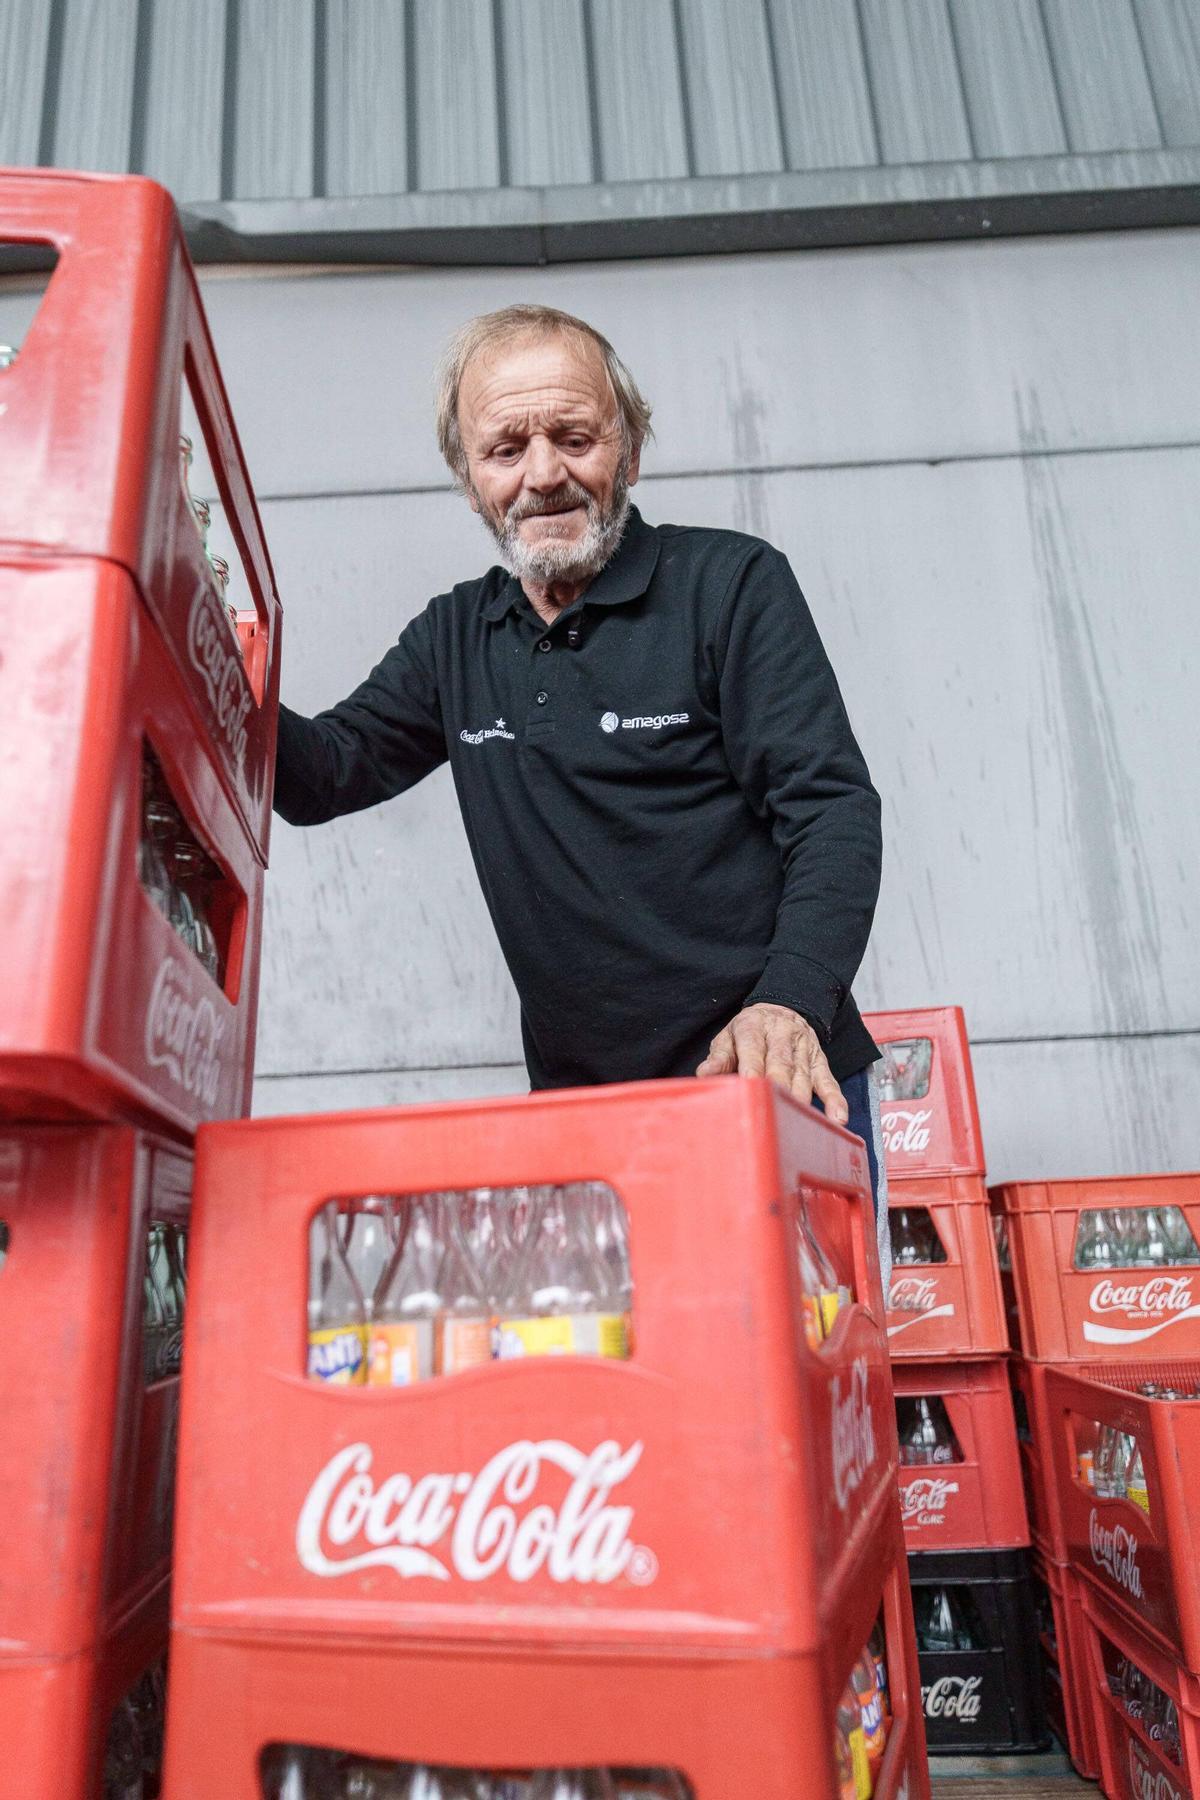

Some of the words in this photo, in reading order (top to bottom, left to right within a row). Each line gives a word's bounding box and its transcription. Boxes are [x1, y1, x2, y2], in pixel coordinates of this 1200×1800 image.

[621, 712, 690, 730] amagosa
[879, 1108, 933, 1153] Cola
[888, 1277, 940, 1313] Cola
[1089, 1276, 1194, 1313] Coca-Cola
[295, 1439, 645, 1583] Coca-Cola
[1089, 1507, 1143, 1599] Coca-Cola
